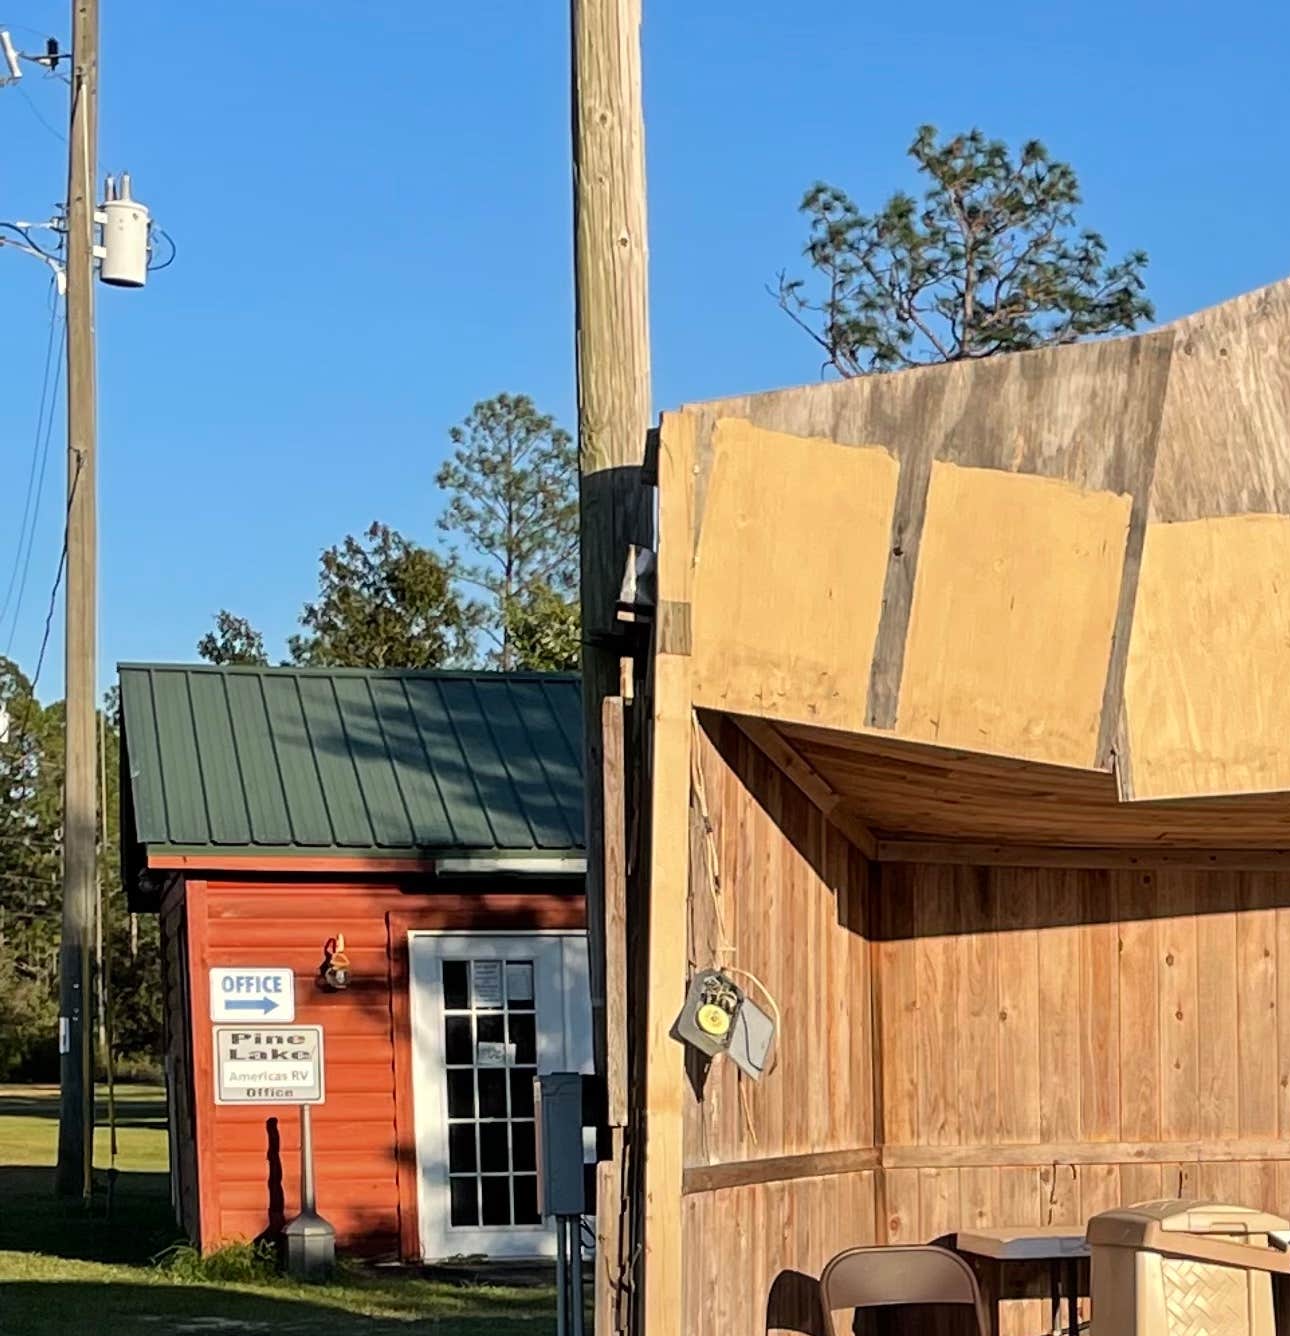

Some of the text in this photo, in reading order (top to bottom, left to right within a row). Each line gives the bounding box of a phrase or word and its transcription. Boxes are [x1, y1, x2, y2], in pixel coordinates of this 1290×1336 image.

[221, 975, 283, 993] OFFICE
[231, 1033, 306, 1045] Pine
[229, 1049, 312, 1060] Lake
[291, 1069, 310, 1081] RV
[246, 1087, 294, 1098] Office
